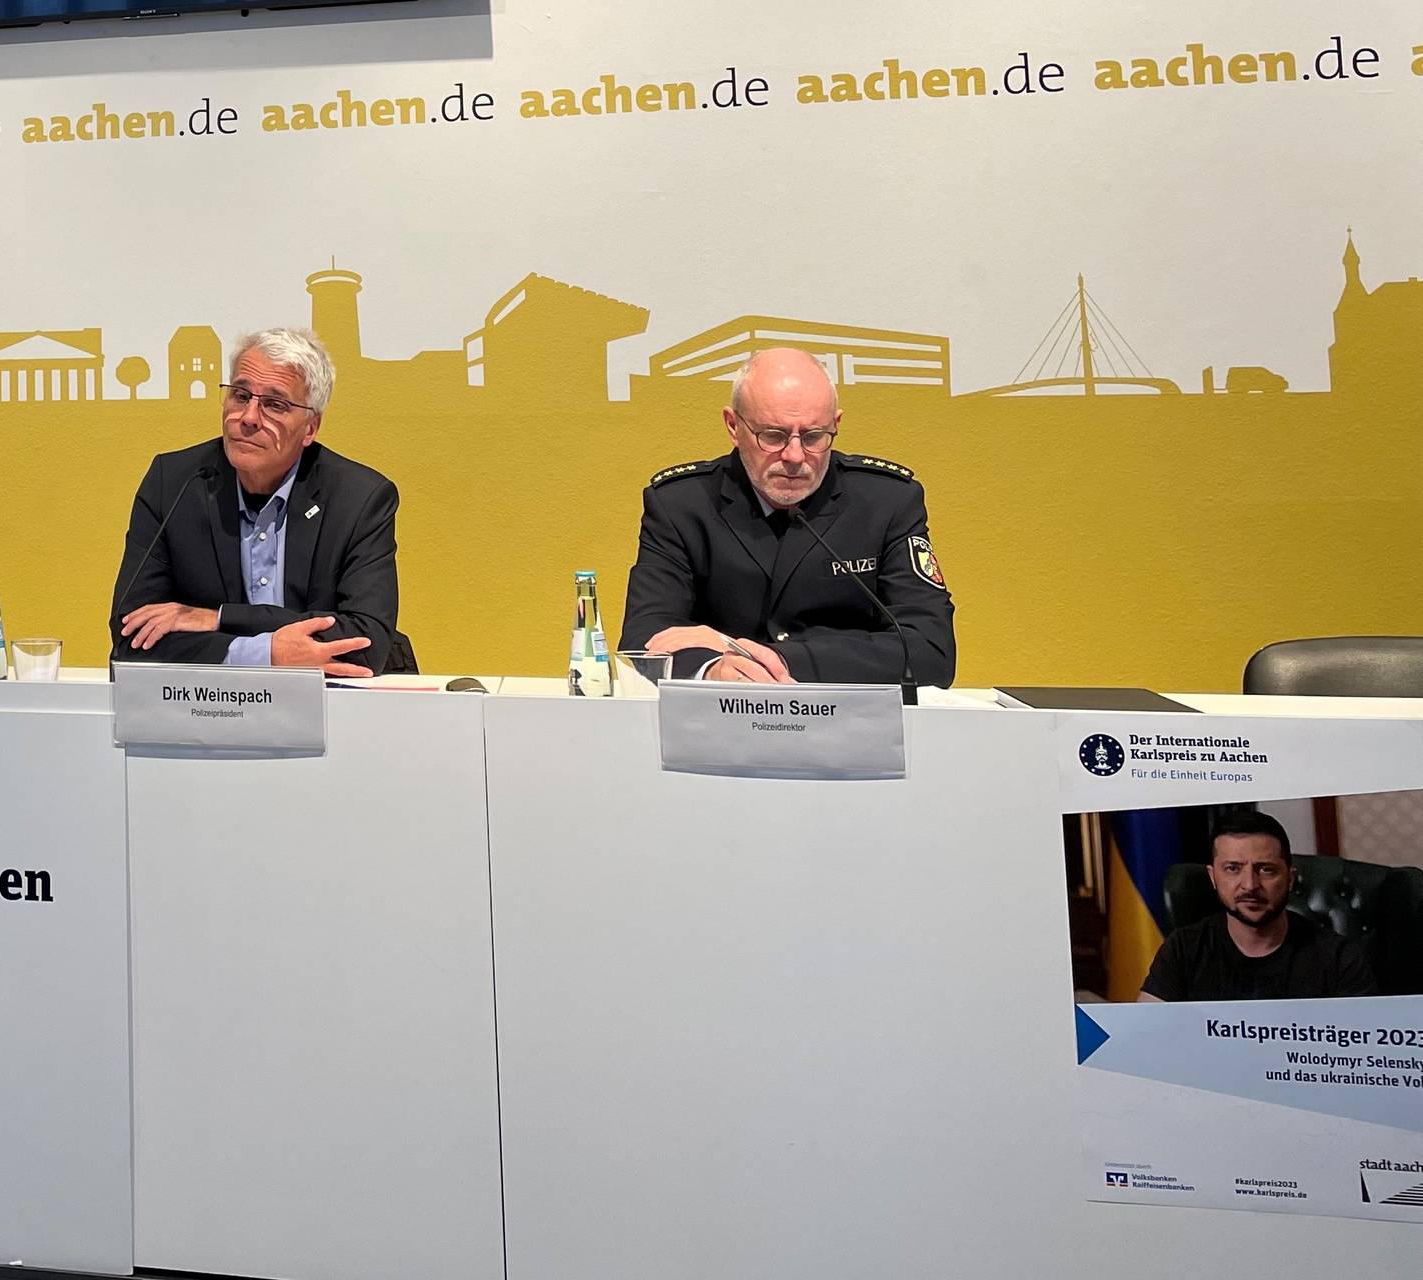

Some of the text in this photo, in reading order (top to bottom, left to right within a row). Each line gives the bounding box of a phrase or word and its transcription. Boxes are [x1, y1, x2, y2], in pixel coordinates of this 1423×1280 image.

[23, 98, 237, 142] aachen.de
[263, 83, 493, 131] aachen.de
[521, 68, 768, 117] aachen.de
[797, 53, 1064, 103] aachen.de
[1095, 36, 1379, 89] aachen.de
[163, 687, 271, 706] Dirk Weinspach
[719, 699, 836, 716] Wilhelm Sauer
[1129, 735, 1249, 748] Der Internationale
[1130, 749, 1267, 763] Karlspreis zu Aachen
[1132, 769, 1252, 783] Für die Einheit Europas
[1207, 1020, 1370, 1047] Karlspreisträger
[1287, 1052, 1362, 1068] Wolodymyr
[1266, 1069, 1290, 1080] und
[1295, 1070, 1317, 1082] das
[1321, 1071, 1399, 1086] ukrainische
[1360, 1159, 1392, 1170] stadt
[1131, 1174, 1177, 1182] Volksbanken
[1235, 1178, 1298, 1189] #karlspreis2023
[1132, 1182, 1195, 1192] Raiffeisenbanken
[1235, 1187, 1307, 1199] www.karlspreis.de
